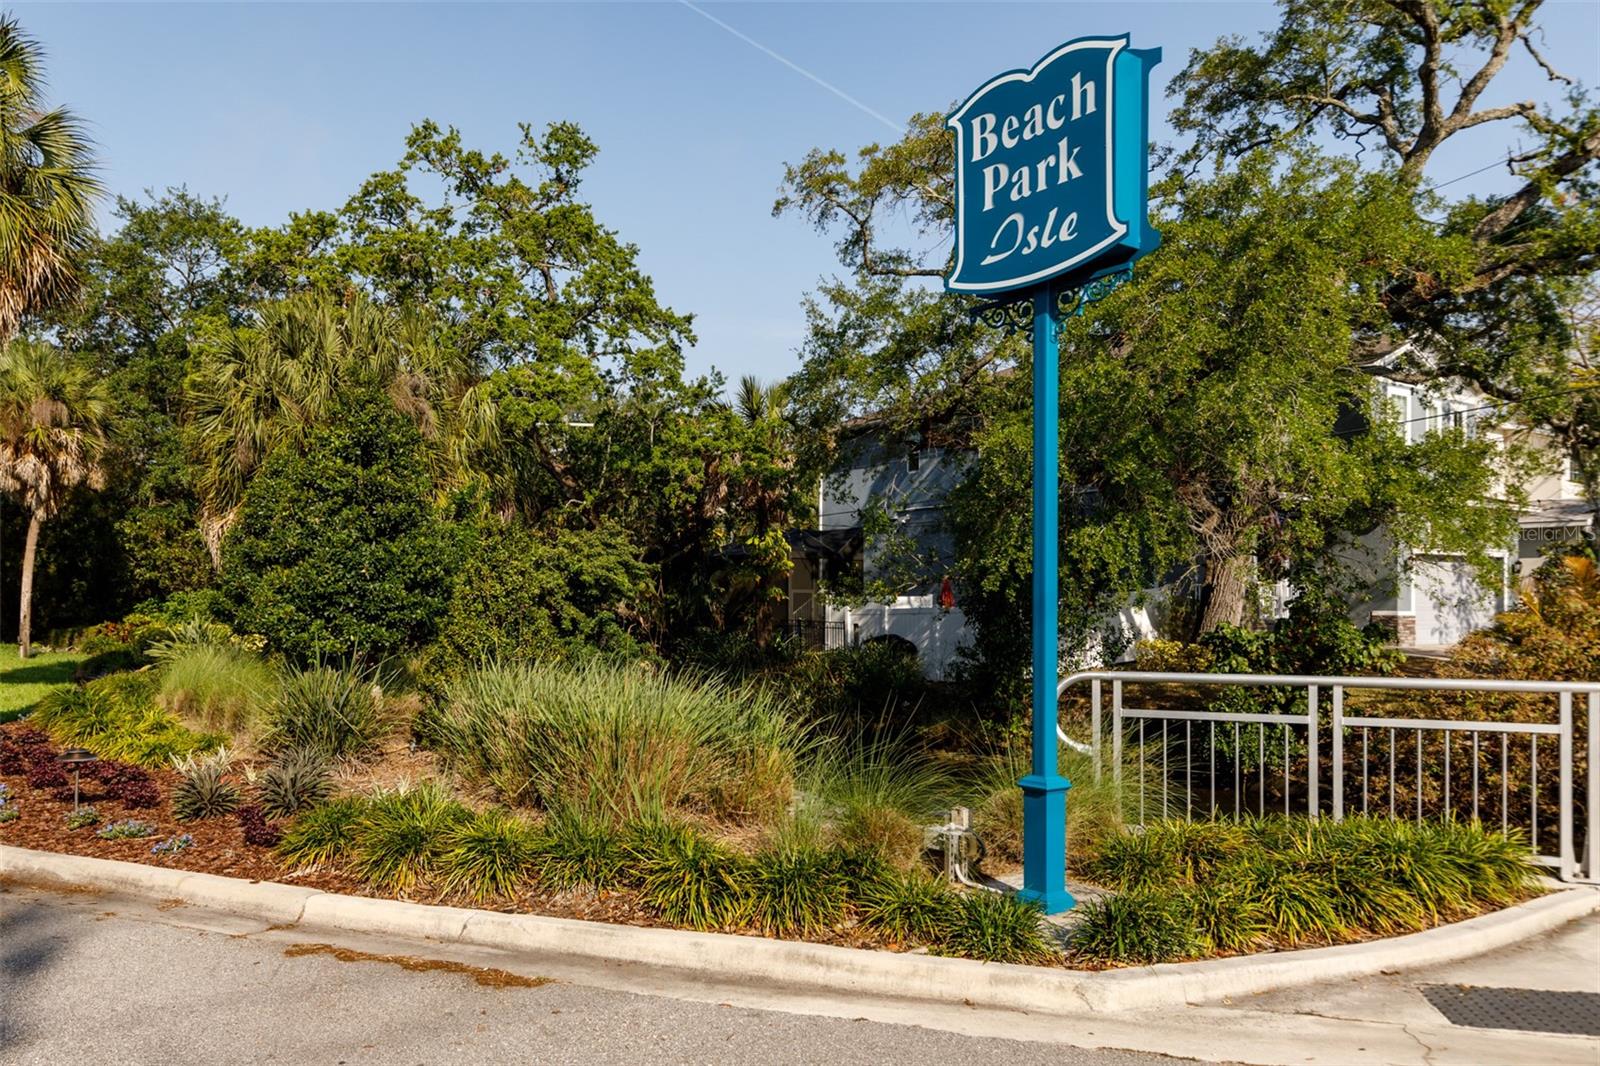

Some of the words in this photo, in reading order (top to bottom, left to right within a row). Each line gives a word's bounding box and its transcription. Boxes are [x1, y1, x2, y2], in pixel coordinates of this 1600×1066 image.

[971, 71, 1097, 163] Beach
[982, 136, 1084, 212] Park
[980, 207, 1078, 266] Isle
